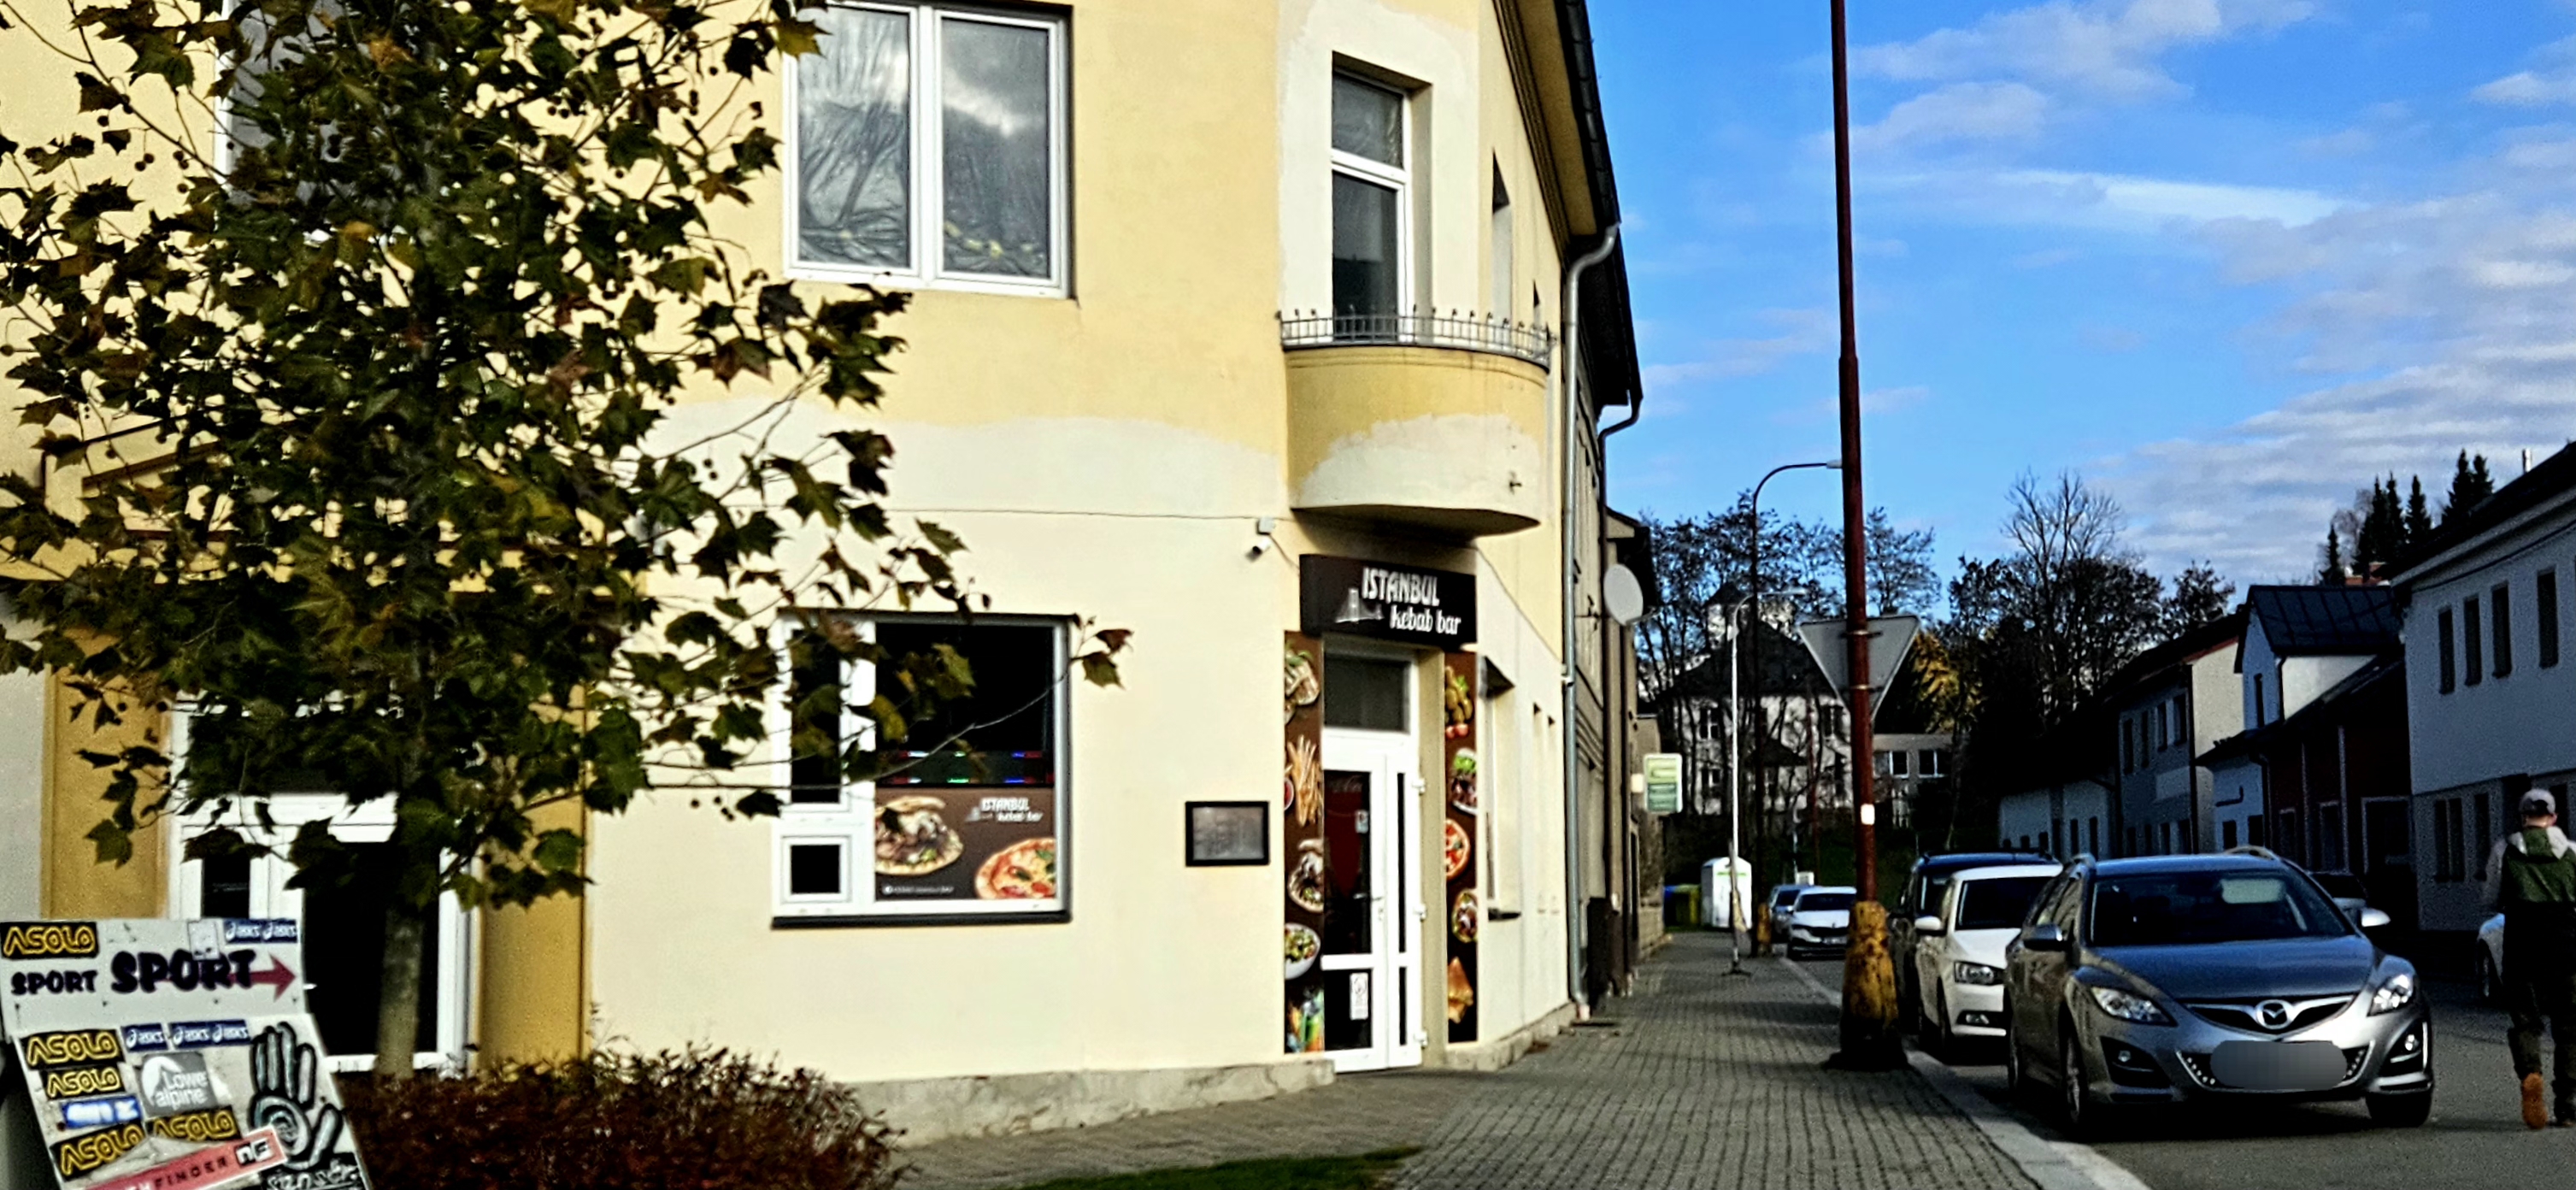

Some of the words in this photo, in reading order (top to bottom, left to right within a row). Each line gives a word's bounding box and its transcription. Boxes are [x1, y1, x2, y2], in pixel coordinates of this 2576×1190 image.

[1362, 567, 1440, 606] ISTANBUL
[1390, 604, 1433, 632] kebab
[1436, 609, 1461, 634] bar
[980, 797, 1030, 811] ISTANBUL
[3, 926, 95, 956] ASOLO
[11, 969, 98, 996] SPORT
[110, 949, 257, 993] SPORT
[27, 1031, 120, 1067] ASOLO
[47, 1067, 121, 1099] ASOLO
[162, 1070, 209, 1089] Lowe
[155, 1087, 208, 1110] alpine
[154, 1109, 238, 1141] ASOLO
[61, 1124, 144, 1176] ASOLO
